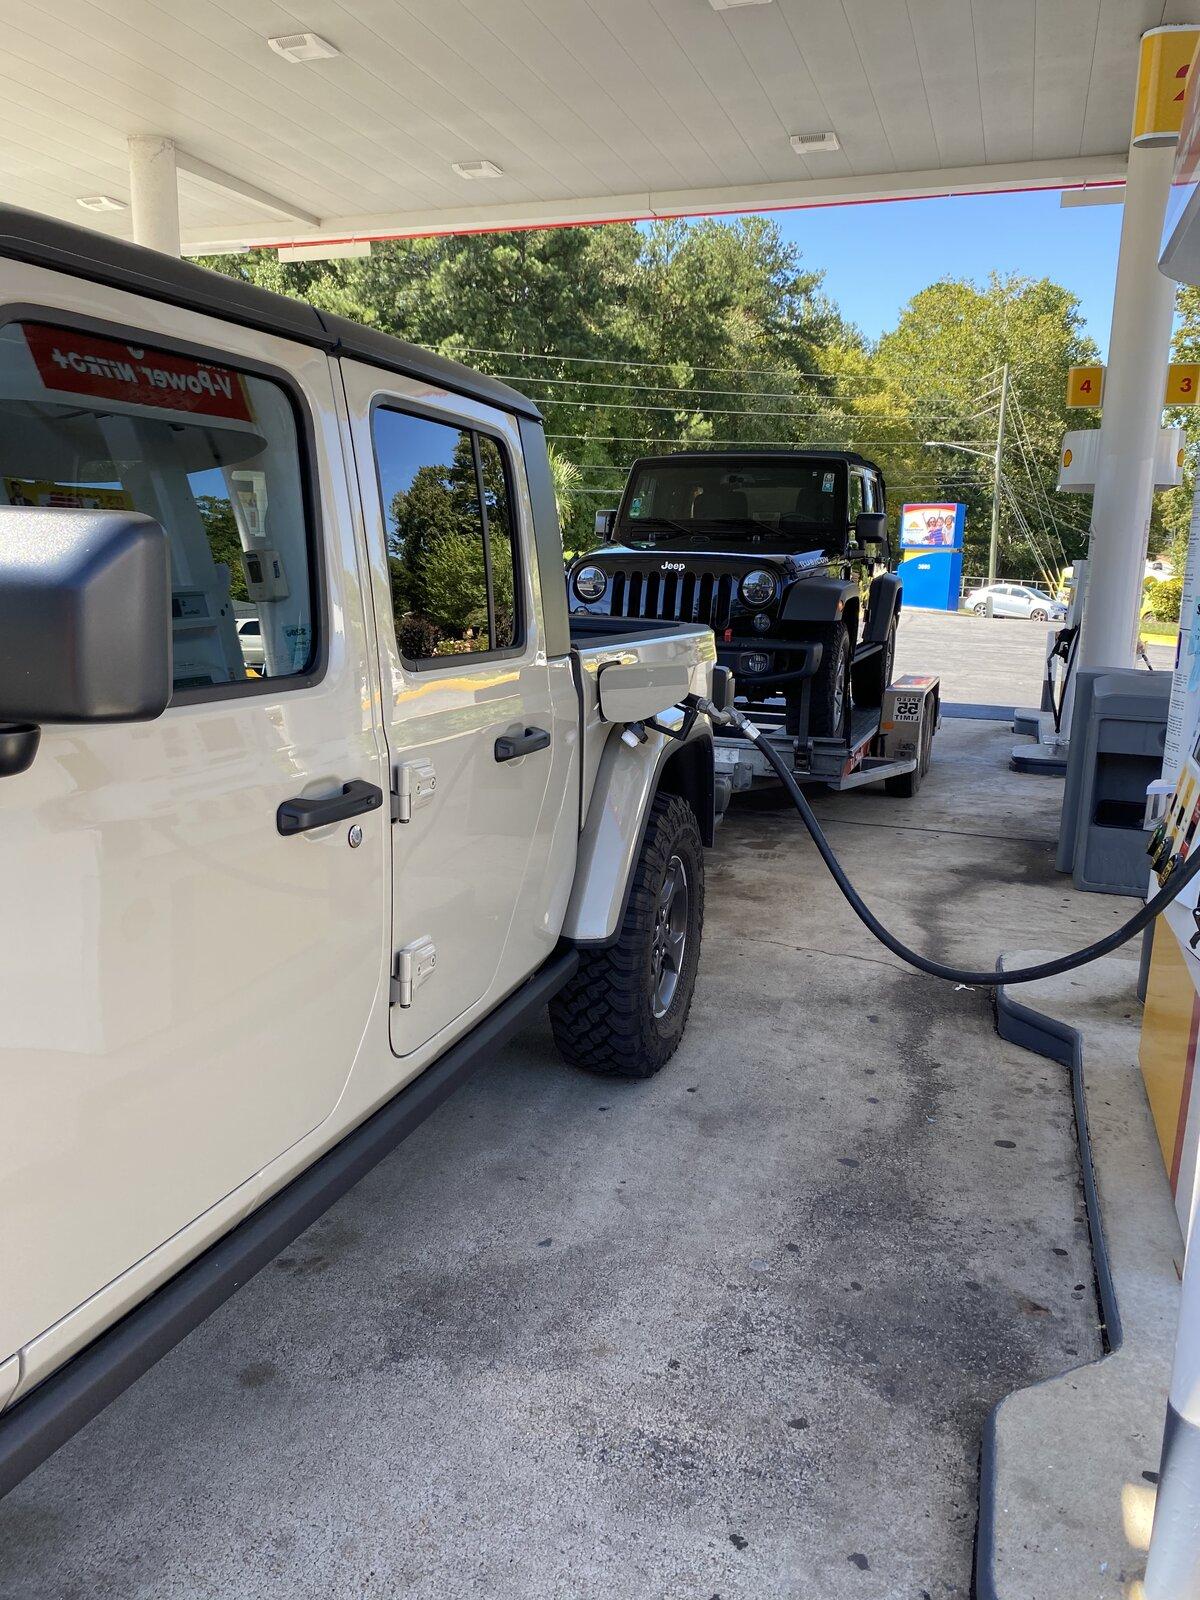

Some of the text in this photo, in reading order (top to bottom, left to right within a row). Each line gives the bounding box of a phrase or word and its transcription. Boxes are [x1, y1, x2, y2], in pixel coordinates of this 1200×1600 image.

[1079, 379, 1092, 394] 4
[1180, 377, 1192, 393] 3
[661, 561, 685, 571] Jeep
[799, 556, 829, 568] RUBICON
